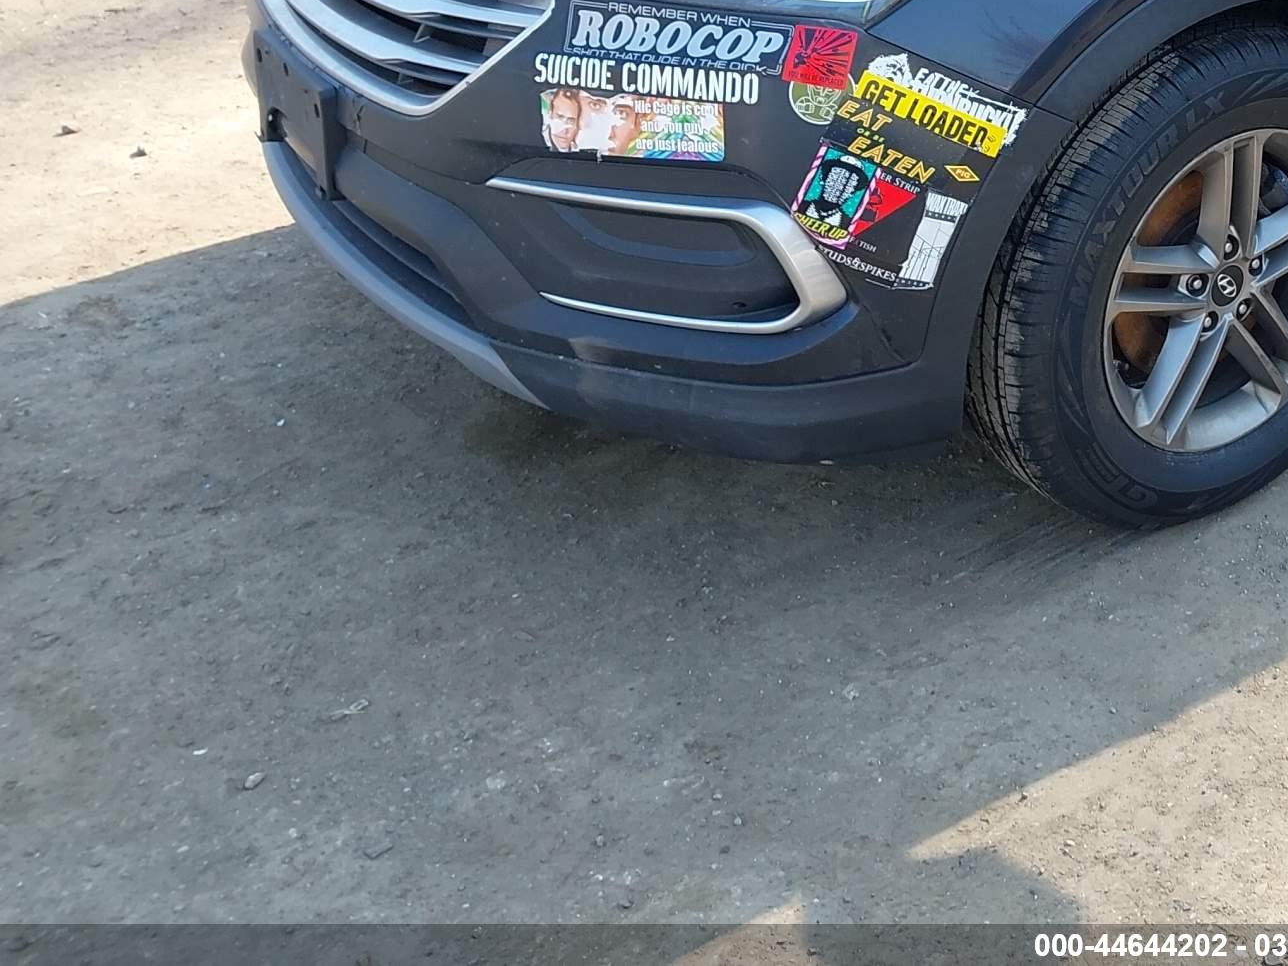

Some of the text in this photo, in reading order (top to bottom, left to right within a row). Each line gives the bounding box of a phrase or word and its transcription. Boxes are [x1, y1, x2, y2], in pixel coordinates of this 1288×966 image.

[608, 2, 751, 28] REMEMBER WHEN
[572, 10, 784, 63] ROBOCOP
[608, 51, 640, 61] THAT
[641, 55, 680, 65] DUDE
[682, 57, 697, 66] IN
[699, 59, 727, 69] THE
[534, 53, 759, 105] SUICIDE COMMANDO
[653, 101, 680, 115] Cage
[682, 102, 692, 115] is
[694, 103, 718, 116] cool
[836, 100, 893, 131] EAT
[862, 79, 908, 113] GET
[906, 95, 990, 150] LOADED
[641, 120, 662, 133] and
[663, 121, 682, 134] you
[636, 138, 718, 153] are just jealous
[848, 136, 936, 184] EATEN
[955, 168, 971, 179] PIG
[794, 211, 849, 241] CHEER UP
